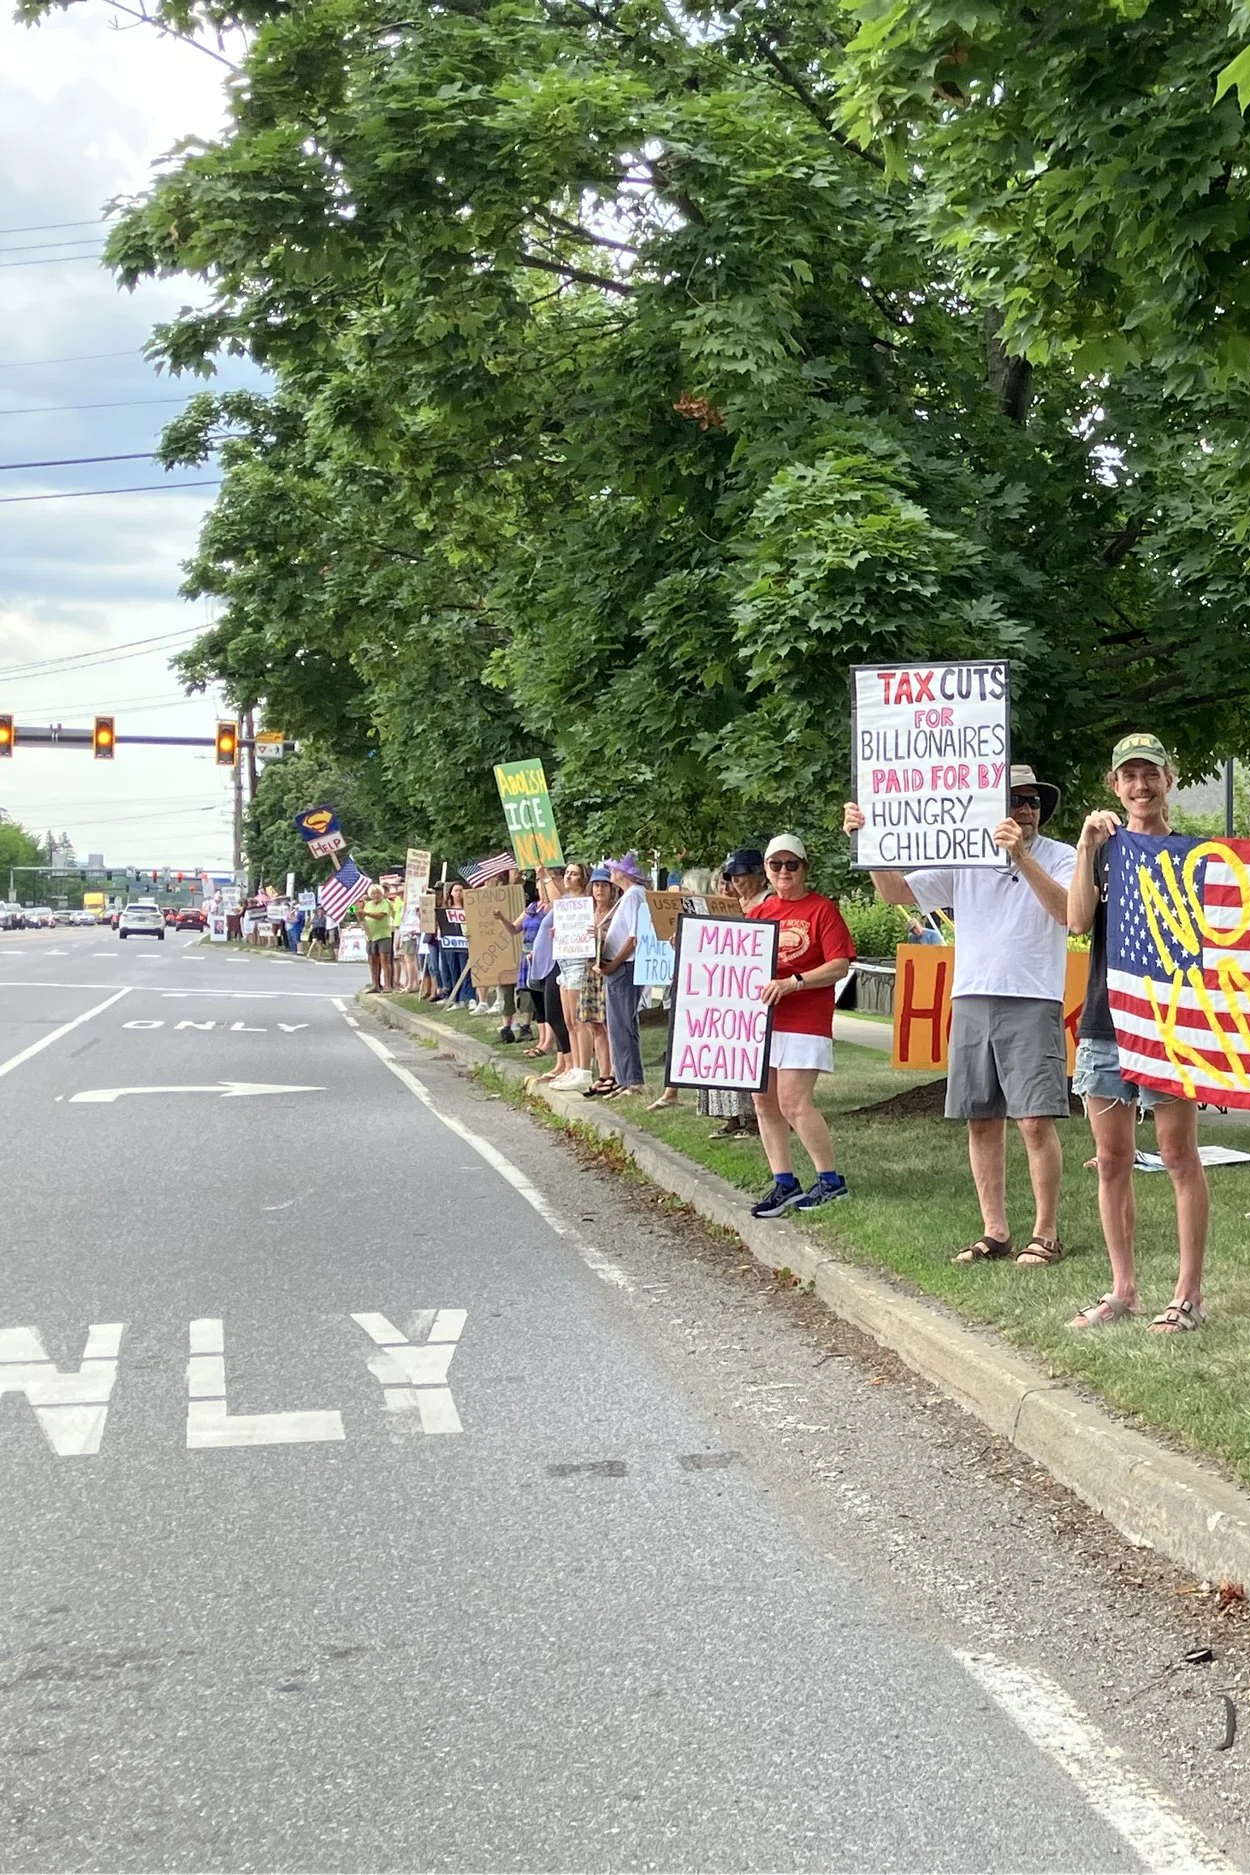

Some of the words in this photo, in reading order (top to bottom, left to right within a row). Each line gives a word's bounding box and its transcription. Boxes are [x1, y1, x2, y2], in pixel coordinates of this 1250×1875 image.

[877, 670, 936, 704] TAX
[940, 665, 1005, 700] CUTS
[914, 707, 954, 728] FOR
[861, 723, 1005, 761] BILLIONAIRES
[872, 768, 924, 793] PAID
[931, 764, 970, 790] FOR
[978, 762, 1005, 789] BY
[504, 798, 546, 830] ICE
[872, 794, 973, 827] HUNGRY
[311, 838, 341, 857] HELP
[514, 828, 560, 868] NOW
[879, 827, 1000, 862] CHILDREN
[465, 888, 507, 906] STAND
[653, 898, 679, 910] USE
[471, 932, 512, 982] PEOPLE
[637, 933, 667, 956] MAKE
[699, 926, 765, 957] MAKE
[686, 963, 763, 1001] LYING
[121, 1020, 310, 1034] ONLY
[686, 1007, 768, 1043] WRONG
[678, 1044, 759, 1081] AGAIN
